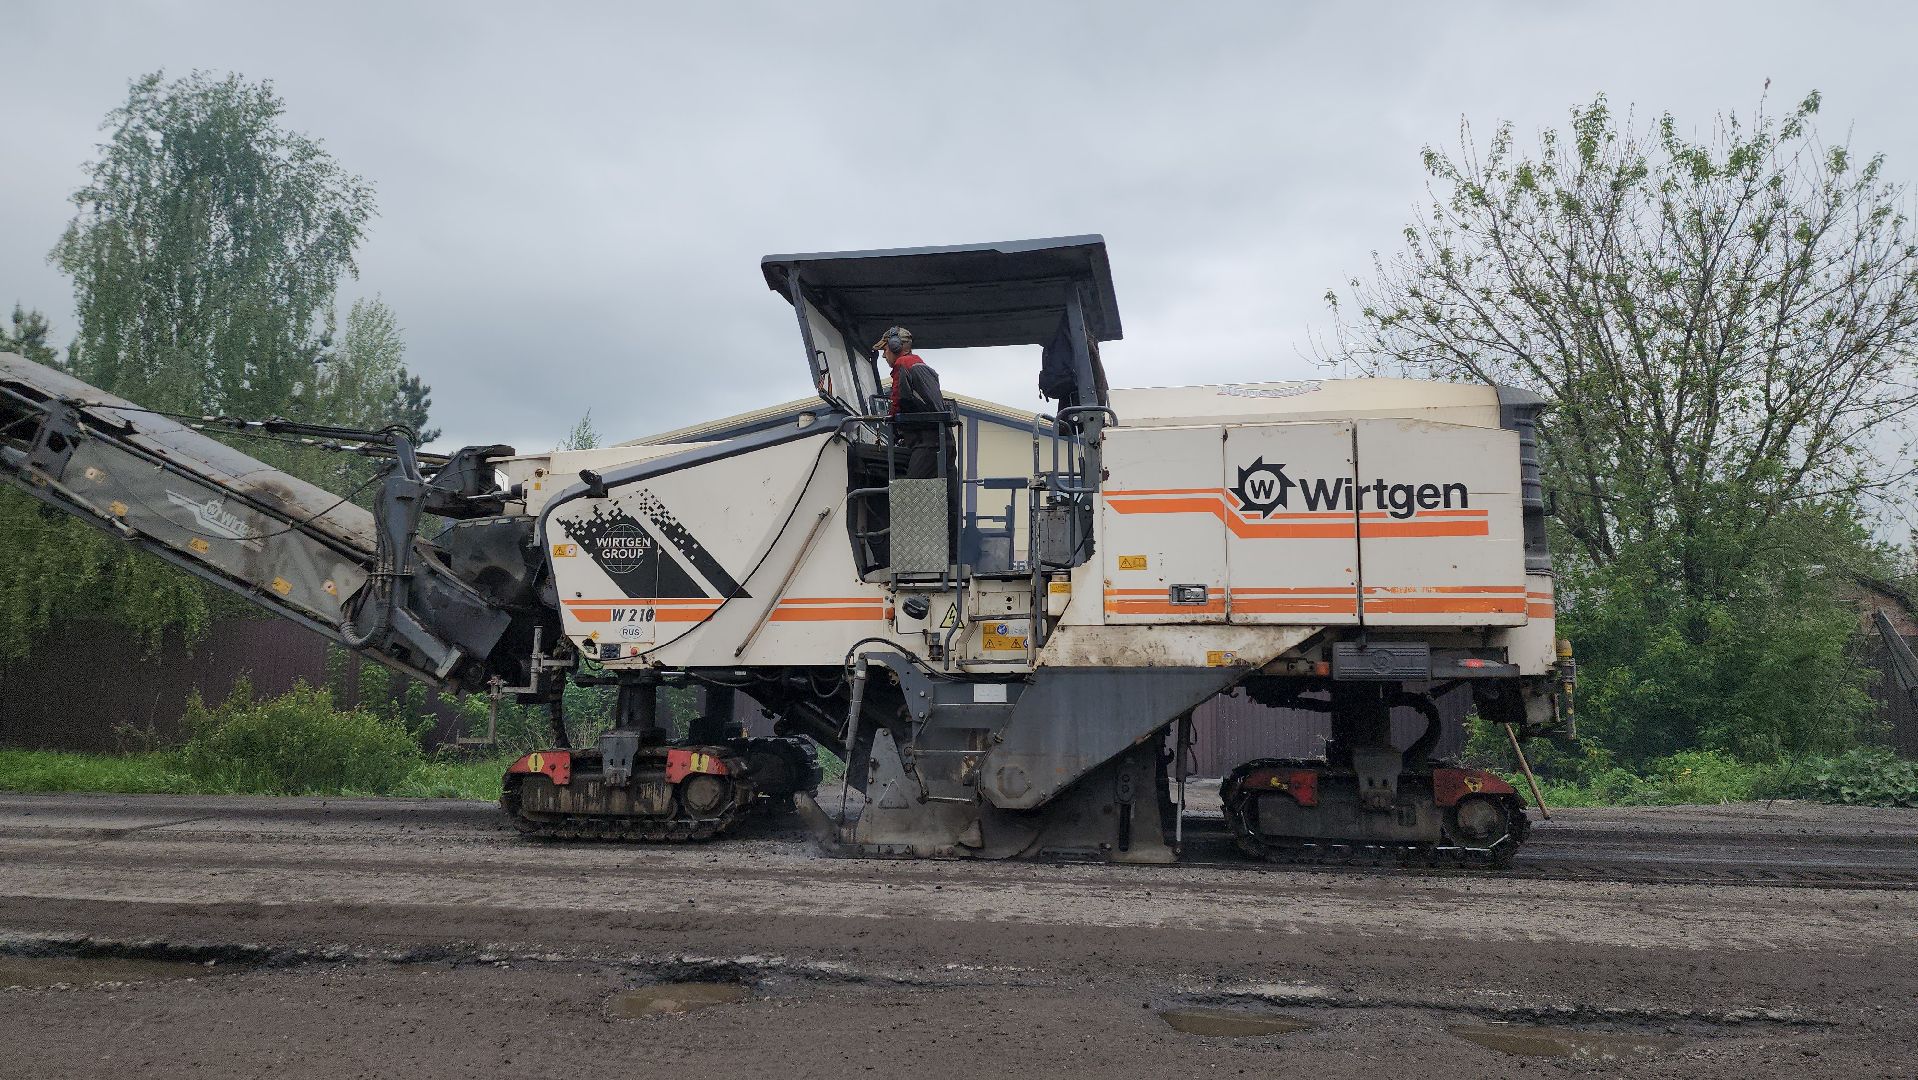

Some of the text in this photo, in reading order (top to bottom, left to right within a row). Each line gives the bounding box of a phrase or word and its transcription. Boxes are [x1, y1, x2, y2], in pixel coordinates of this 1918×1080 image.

[1250, 477, 1469, 519] W Wirtgen
[595, 537, 651, 548] WIRTGEN
[601, 549, 644, 559] GROUP
[612, 608, 655, 622] W 210
[622, 628, 640, 636] RUS
